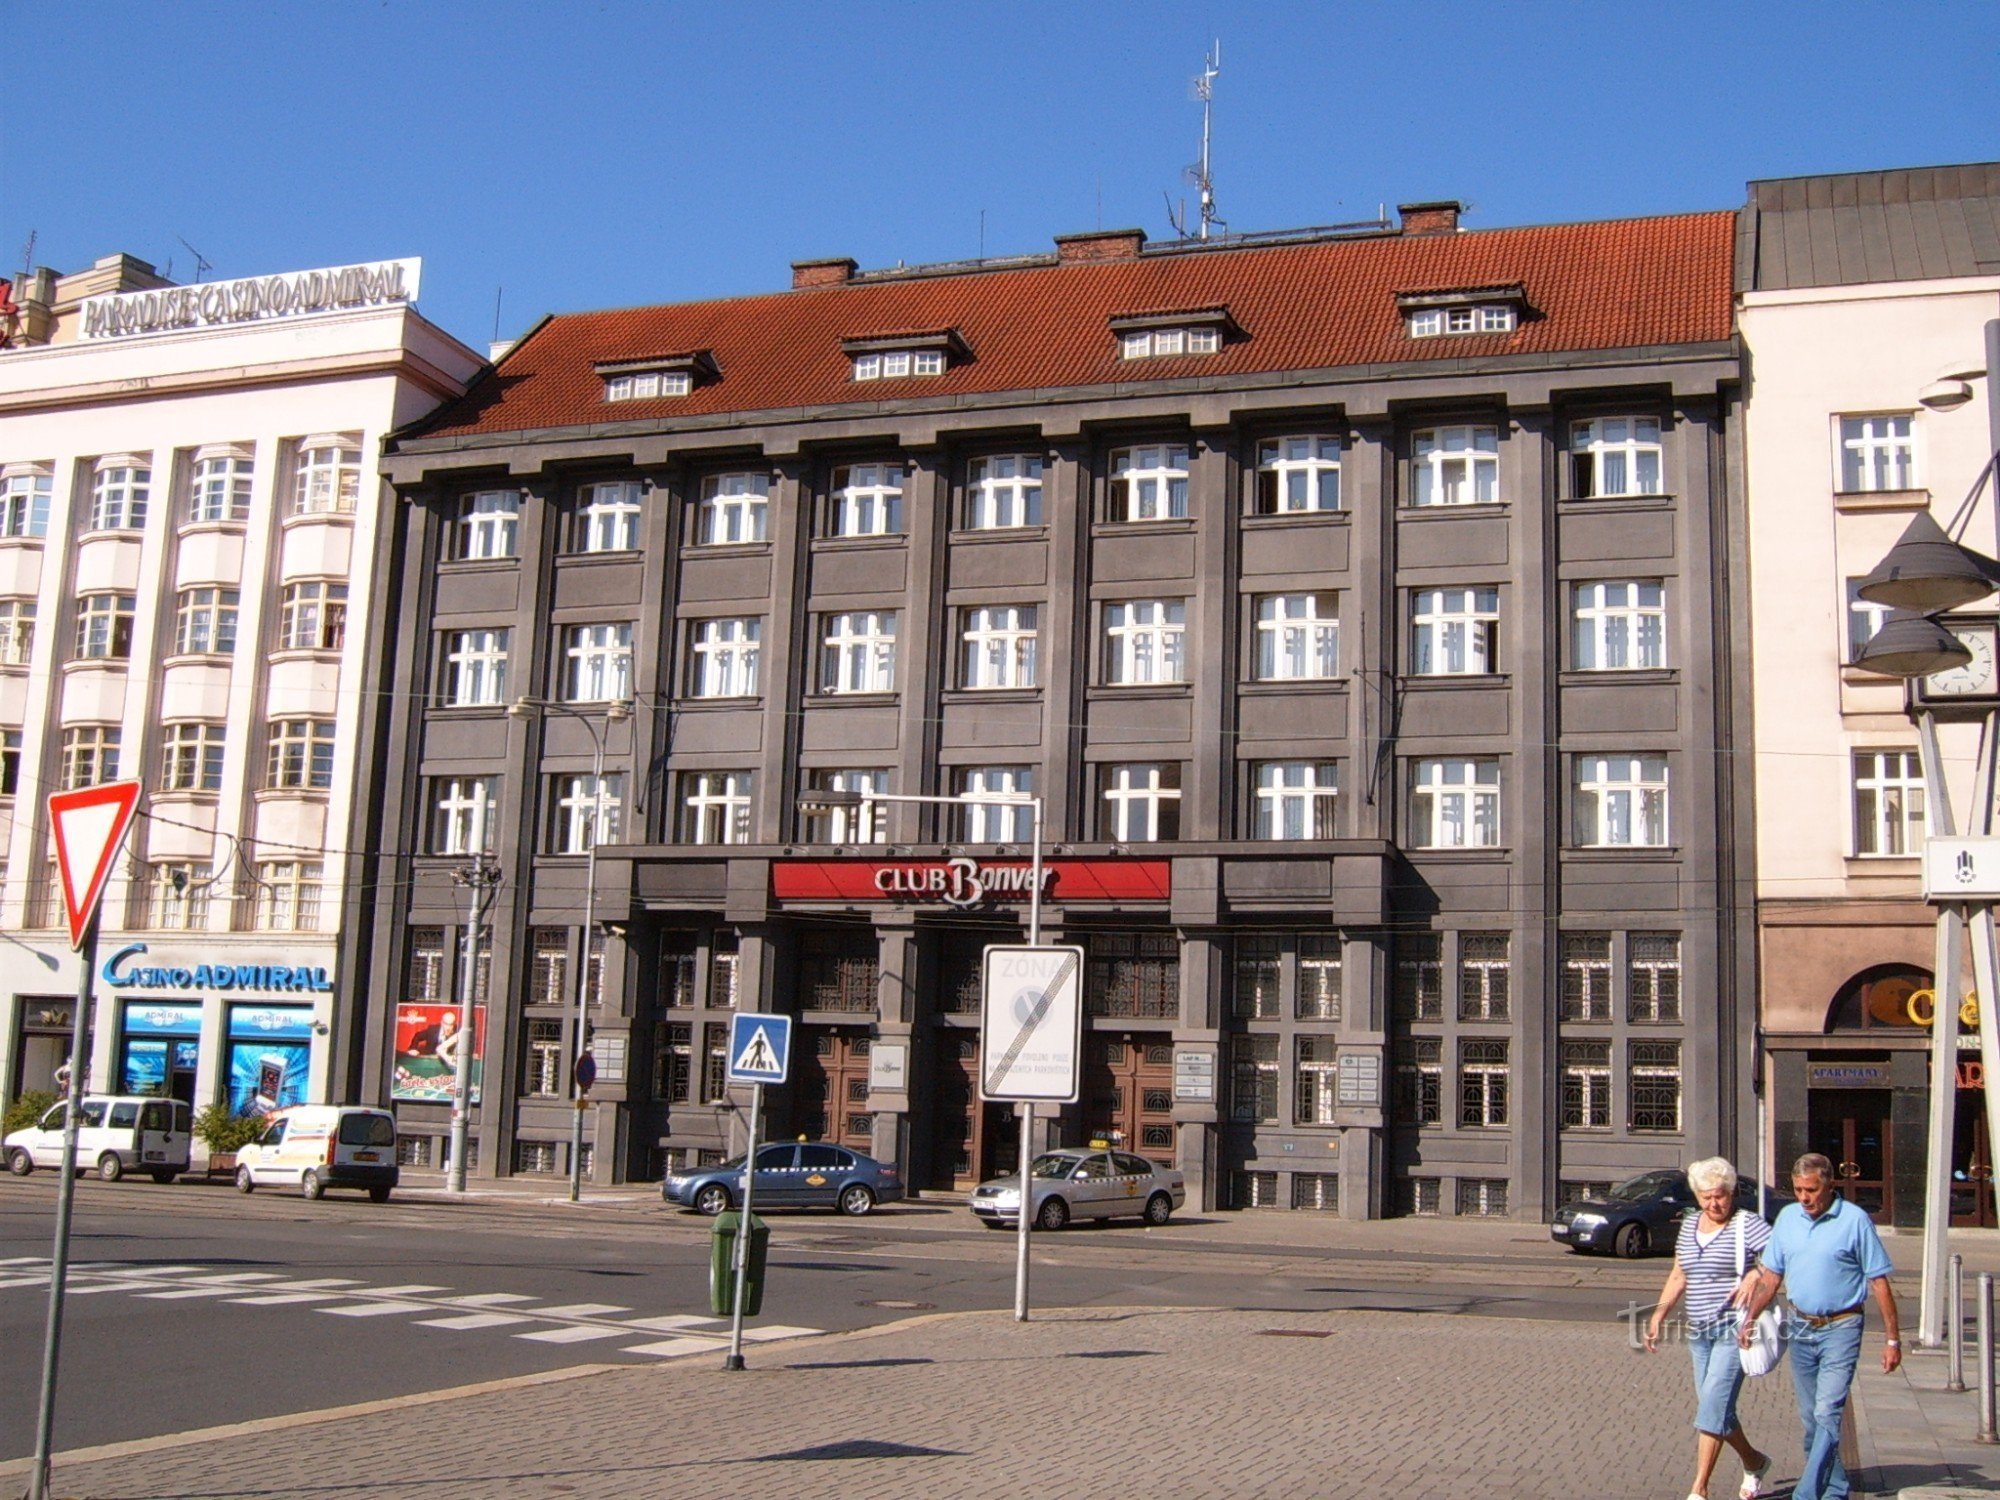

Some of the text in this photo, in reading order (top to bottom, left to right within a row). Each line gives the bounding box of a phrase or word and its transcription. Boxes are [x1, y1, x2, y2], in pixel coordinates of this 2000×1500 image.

[84, 263, 408, 334] PARADISE CASINO ADMIRAL
[874, 858, 1053, 905] CLUB Bonver
[192, 965, 331, 990] ADMIRAL
[145, 1012, 184, 1021] ADMIRAL
[252, 1015, 292, 1023] ADMIRAL
